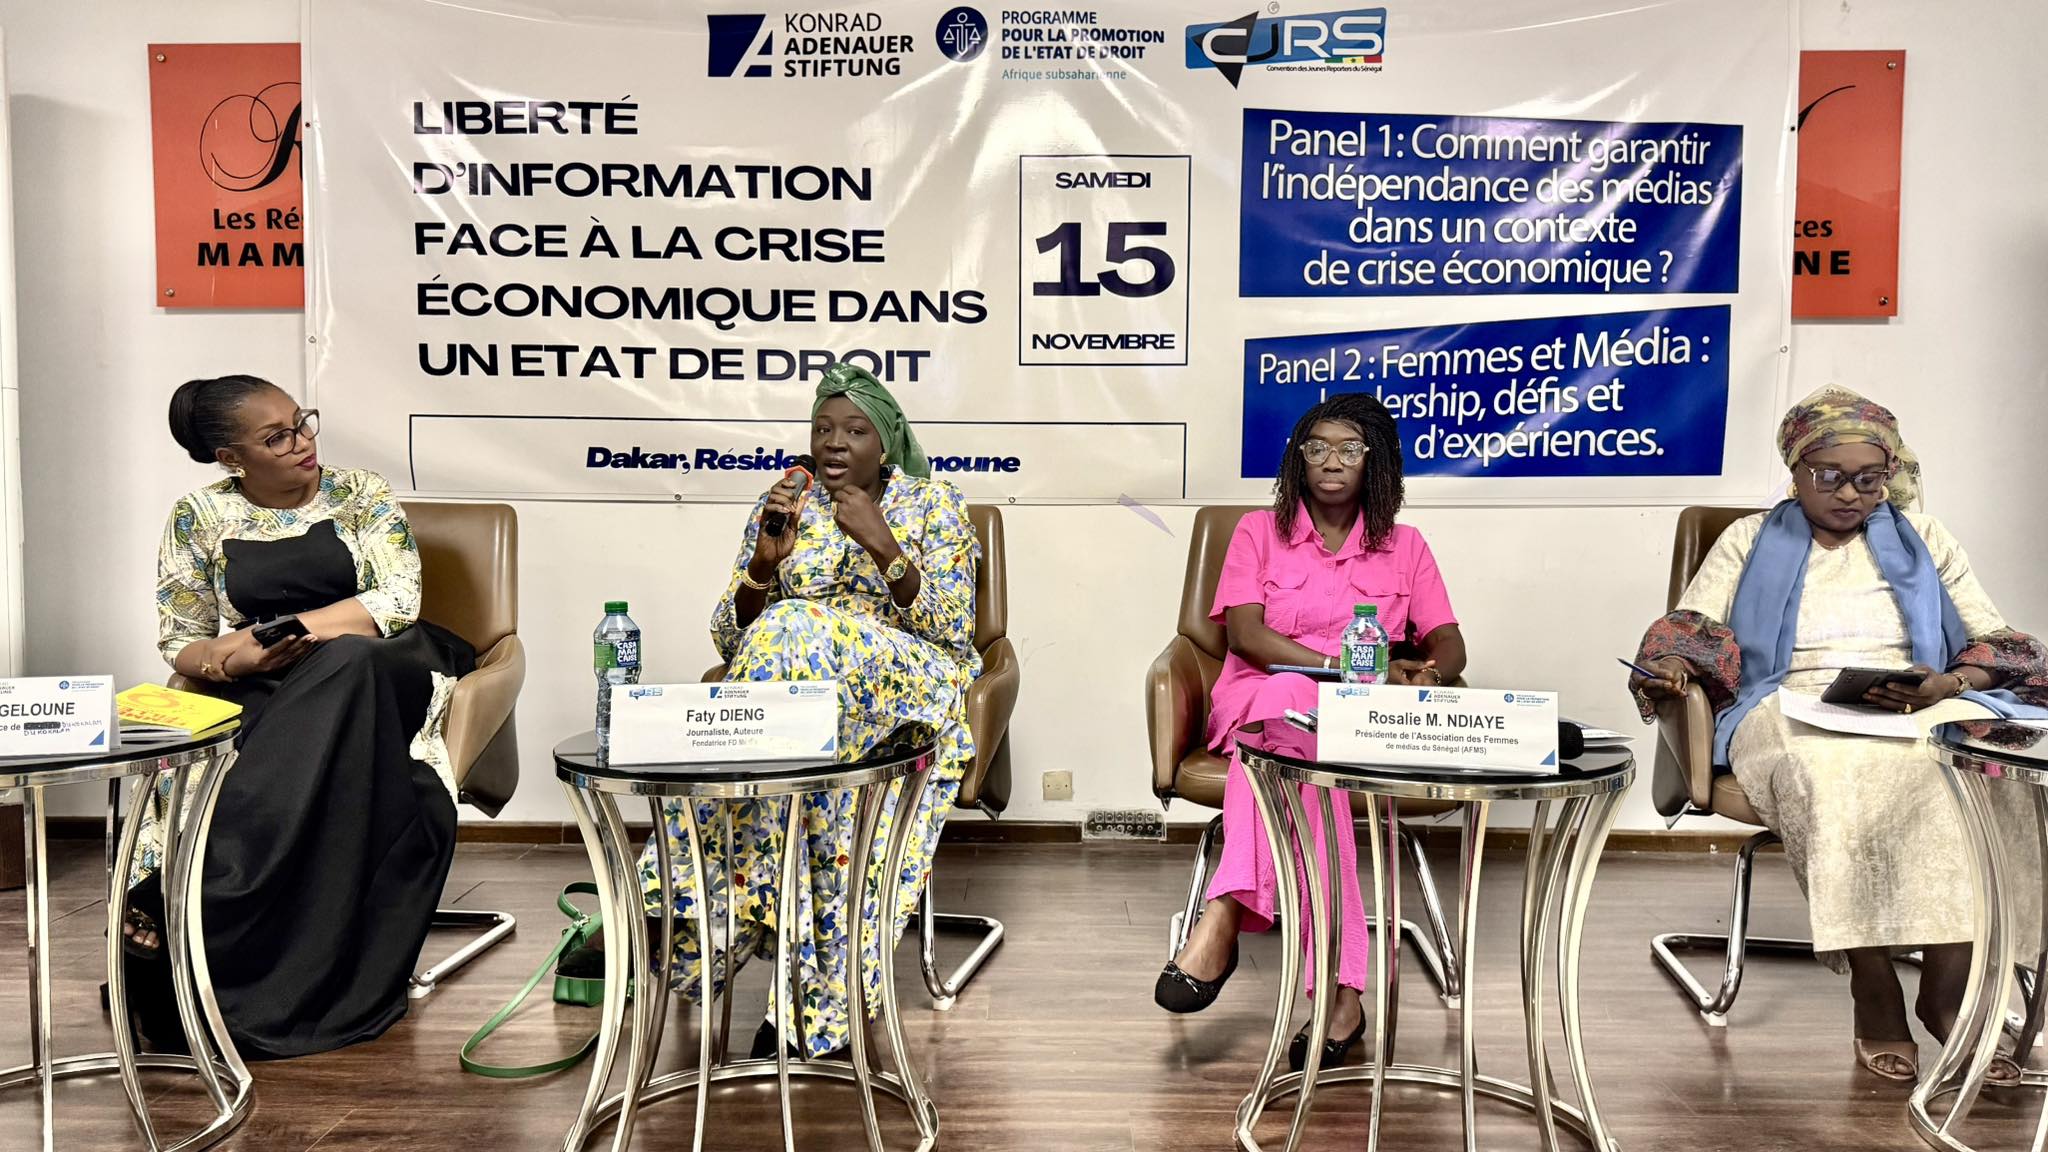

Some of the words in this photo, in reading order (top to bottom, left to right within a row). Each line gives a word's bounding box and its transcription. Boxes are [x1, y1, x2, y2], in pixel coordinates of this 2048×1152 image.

[785, 13, 882, 33] KONRAD
[1002, 10, 1097, 24] PROGRAMME
[784, 35, 914, 55] ADENAUER
[1002, 28, 1044, 42] POUR
[1048, 28, 1067, 42] LA
[1071, 28, 1165, 43] PROMOTION
[1202, 16, 1383, 64] CJRS
[1002, 46, 1020, 59] DE
[1024, 46, 1073, 59] L'ETAT
[1077, 46, 1095, 59] DE
[1099, 46, 1146, 59] DROIT
[784, 57, 900, 77] STIFTUNG
[1002, 68, 1042, 83] Afrique
[1045, 68, 1127, 80] subsaharnne
[1327, 65, 1353, 73] Reporters
[1361, 64, 1383, 73] Sénégal
[413, 95, 638, 135] LIBERTÉ
[1270, 119, 1366, 157] Panel
[1411, 124, 1582, 163] Comment
[1588, 132, 1711, 172] garantir
[413, 162, 872, 201] D’INFORMATION
[1055, 172, 1151, 189] SAMEDI
[1262, 162, 1529, 209] l’indépendance
[1535, 168, 1594, 204] des
[1602, 169, 1713, 205] médias
[213, 208, 256, 230] Les
[266, 206, 304, 230] Ré
[1349, 207, 1433, 243] dans
[1441, 217, 1485, 243] un
[1494, 213, 1637, 243] contexte
[415, 222, 568, 258] FACE
[579, 216, 620, 258] À
[632, 226, 703, 259] LA
[715, 226, 885, 262] CRISE
[1033, 222, 1176, 298] 15
[1793, 251, 1851, 275] NE
[1304, 250, 1350, 286] de
[1357, 251, 1435, 286] crise
[1442, 250, 1651, 292] économique
[1659, 250, 1674, 283] ?
[417, 274, 816, 331] ÉCONOMIQUE
[829, 290, 988, 324] DANS
[1032, 334, 1175, 350] NOVEMBRE
[419, 343, 499, 377] UN
[511, 344, 657, 379] ETAT
[669, 347, 744, 380] DE
[757, 349, 931, 382] DROIT
[1259, 348, 1335, 384] Panel
[1382, 345, 1523, 379] Femmes
[1530, 337, 1566, 372] et
[1573, 326, 1691, 369] Média
[1320, 382, 1486, 426] ership,
[1493, 376, 1579, 416] défis
[1587, 377, 1625, 413] et
[586, 447, 691, 474] Dakar,
[694, 447, 801, 470] Réside
[617, 640, 637, 649] CASA
[1351, 645, 1374, 654] CASA
[0, 702, 75, 717] GELOUNE
[686, 709, 715, 725] Faty
[720, 708, 764, 721] DIENG
[10, 723, 21, 731] de
[1369, 711, 1421, 725] Rosalie
[1426, 713, 1442, 727] M.
[1447, 714, 1505, 729] NDIAYE
[686, 728, 731, 737] Journaliste,
[1355, 730, 1397, 739] Présidente
[1399, 732, 1409, 740] de
[1411, 732, 1464, 742] l'Association
[1466, 734, 1481, 743] des
[1483, 735, 1519, 745] Femmes
[1396, 743, 1420, 751] médias
[1432, 745, 1460, 753] Sénégal
[1461, 746, 1487, 755] (AFMS)
